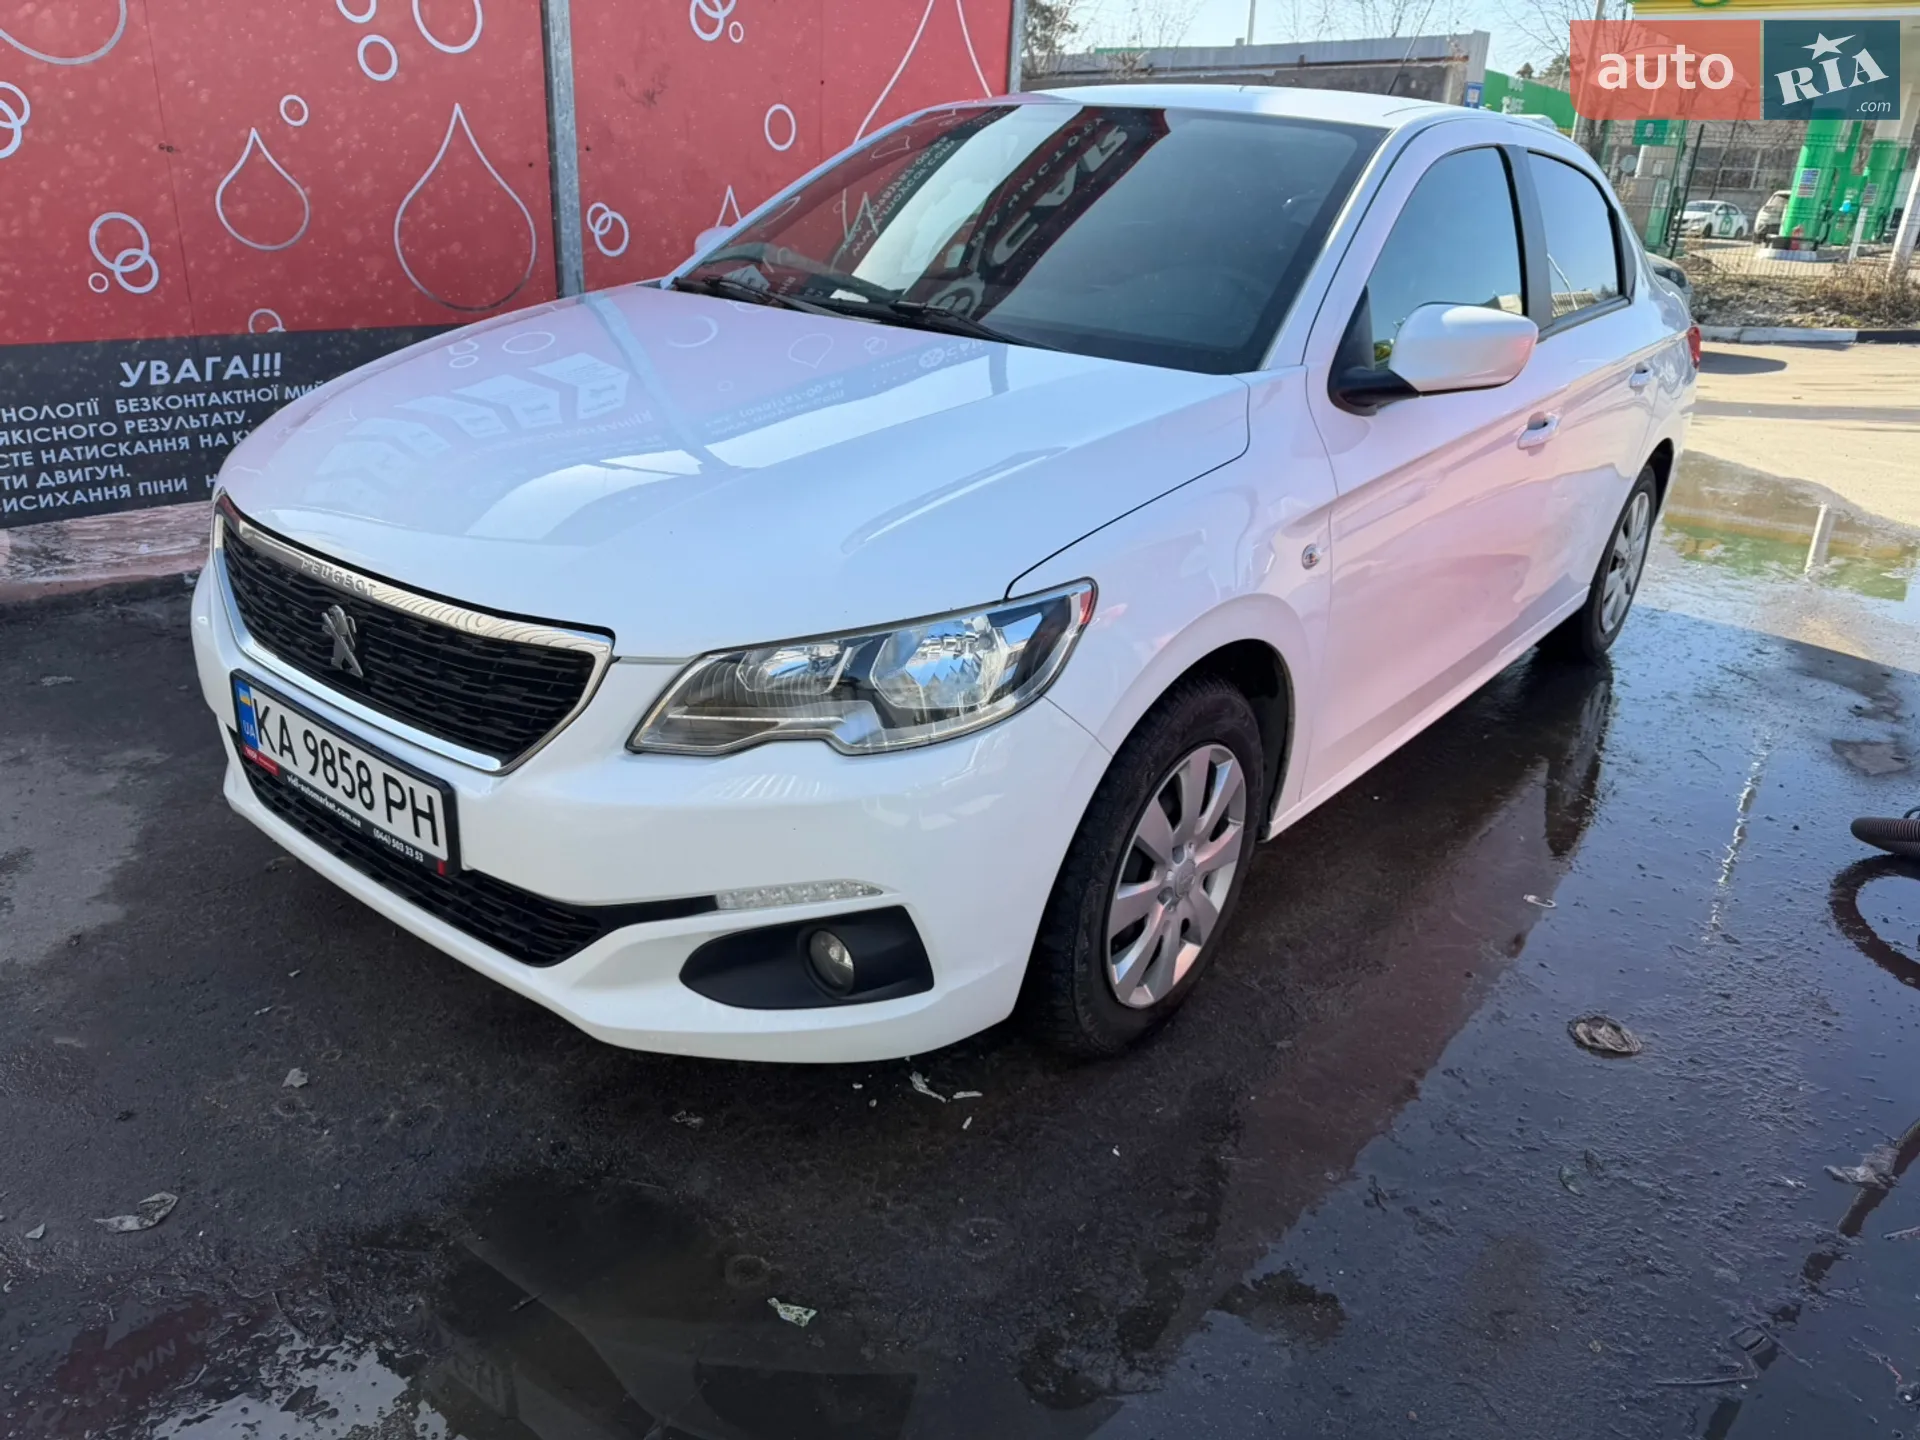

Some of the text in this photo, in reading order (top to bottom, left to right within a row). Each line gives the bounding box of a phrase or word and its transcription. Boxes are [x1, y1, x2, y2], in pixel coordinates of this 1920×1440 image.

[119, 352, 282, 388] УВАГА!!!
[115, 384, 279, 414] БЕЗКОНТАКТНОЇ
[124, 410, 252, 434] РЕЗУЛЬТАТУ.
[41, 436, 190, 464] НАТИСКАННЯ
[199, 433, 229, 448] НА
[36, 464, 131, 489] ДВИГУН.
[138, 477, 188, 496] ПІНИ
[301, 558, 377, 596] PEUGEOT
[253, 698, 439, 847] KA 9858 PH
[373, 828, 392, 846] (044)
